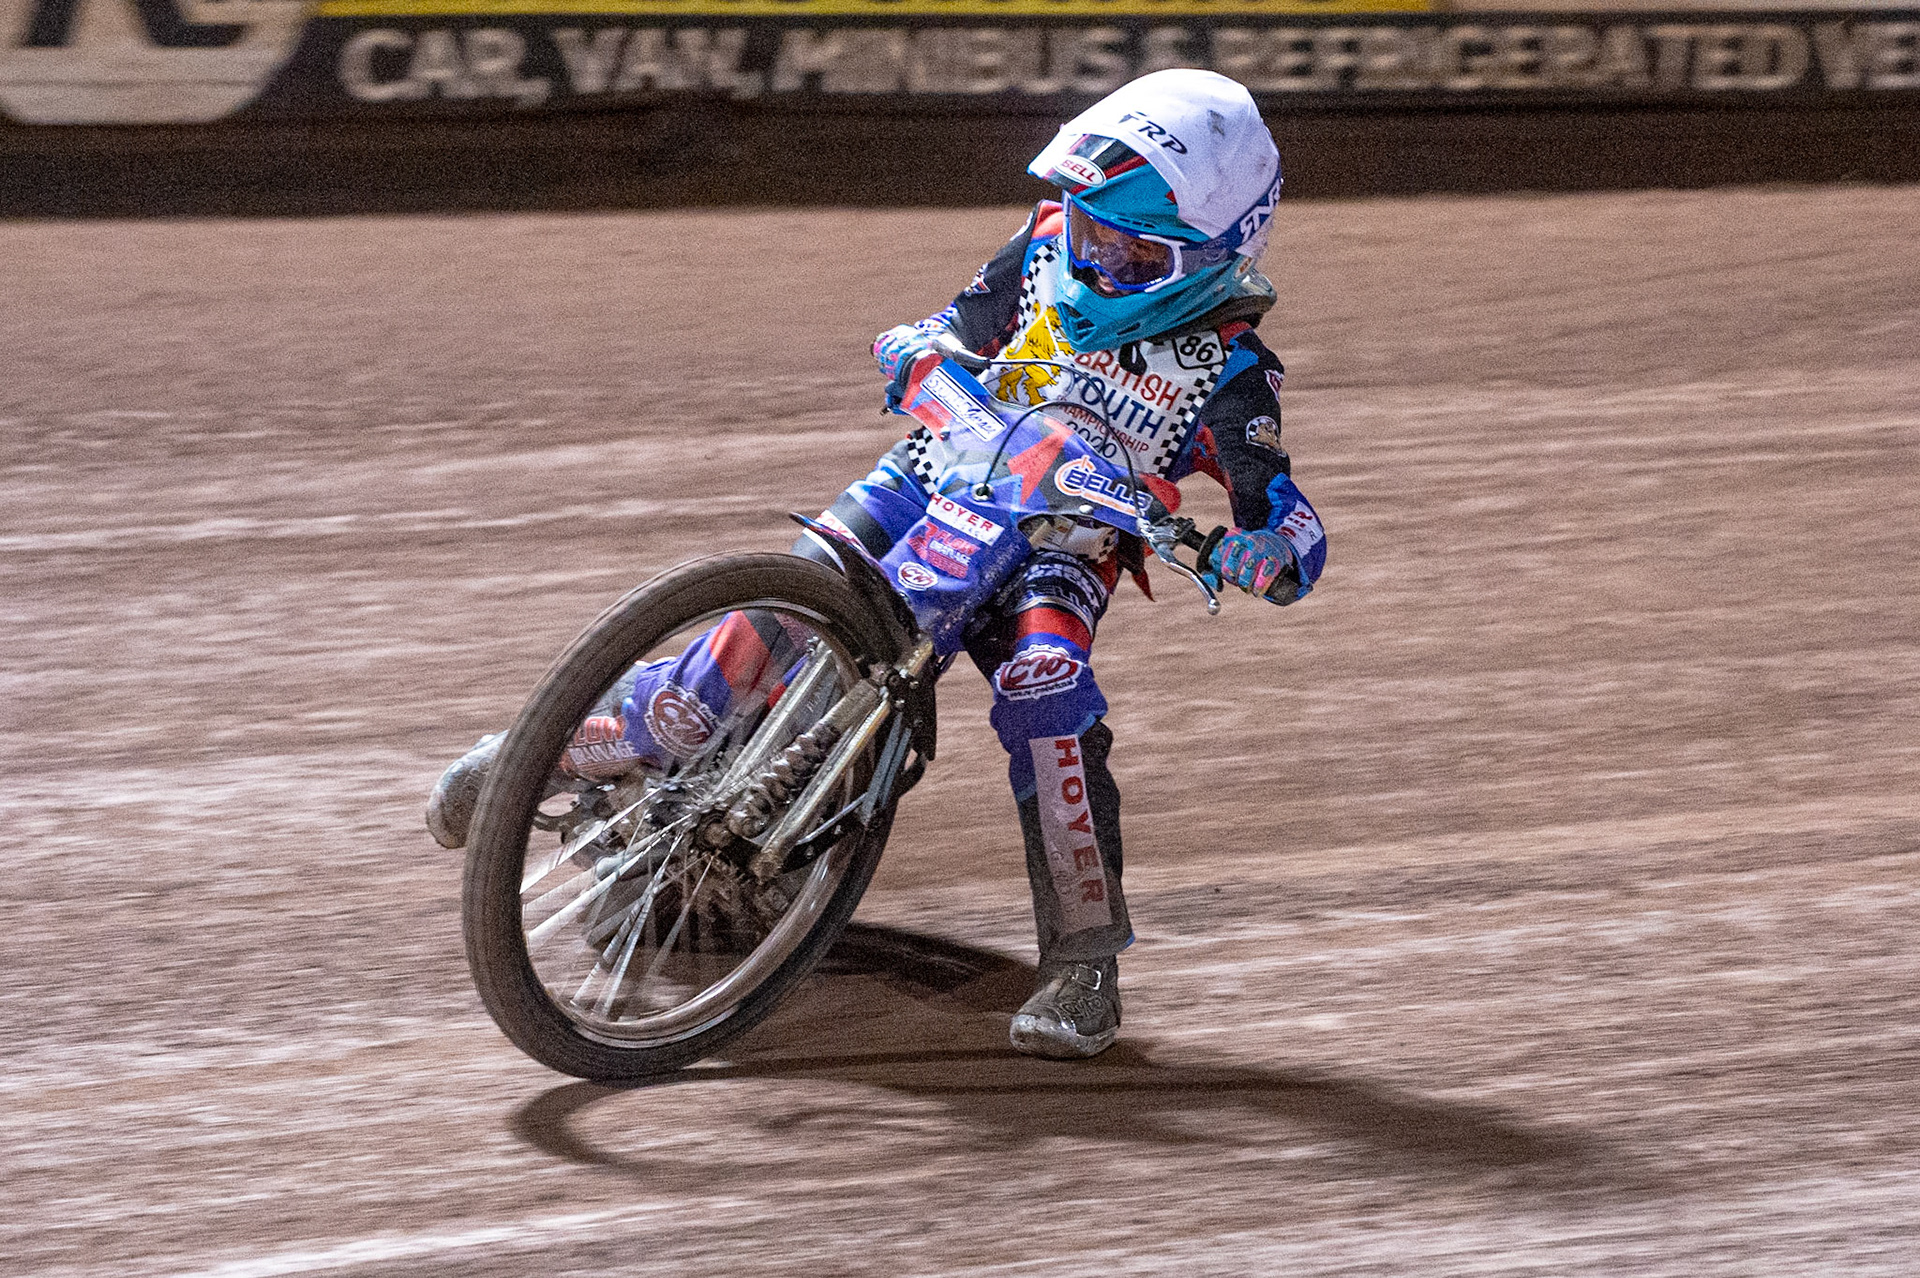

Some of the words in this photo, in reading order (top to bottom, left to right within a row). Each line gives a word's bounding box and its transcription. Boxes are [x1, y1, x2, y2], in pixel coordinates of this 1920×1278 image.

[1061, 159, 1096, 183] BELL
[1180, 335, 1218, 363] 86
[1074, 349, 1183, 411] BRITISH
[931, 493, 994, 532] HOYER
[574, 715, 627, 746] LOW
[1054, 737, 1105, 903] HOYER
